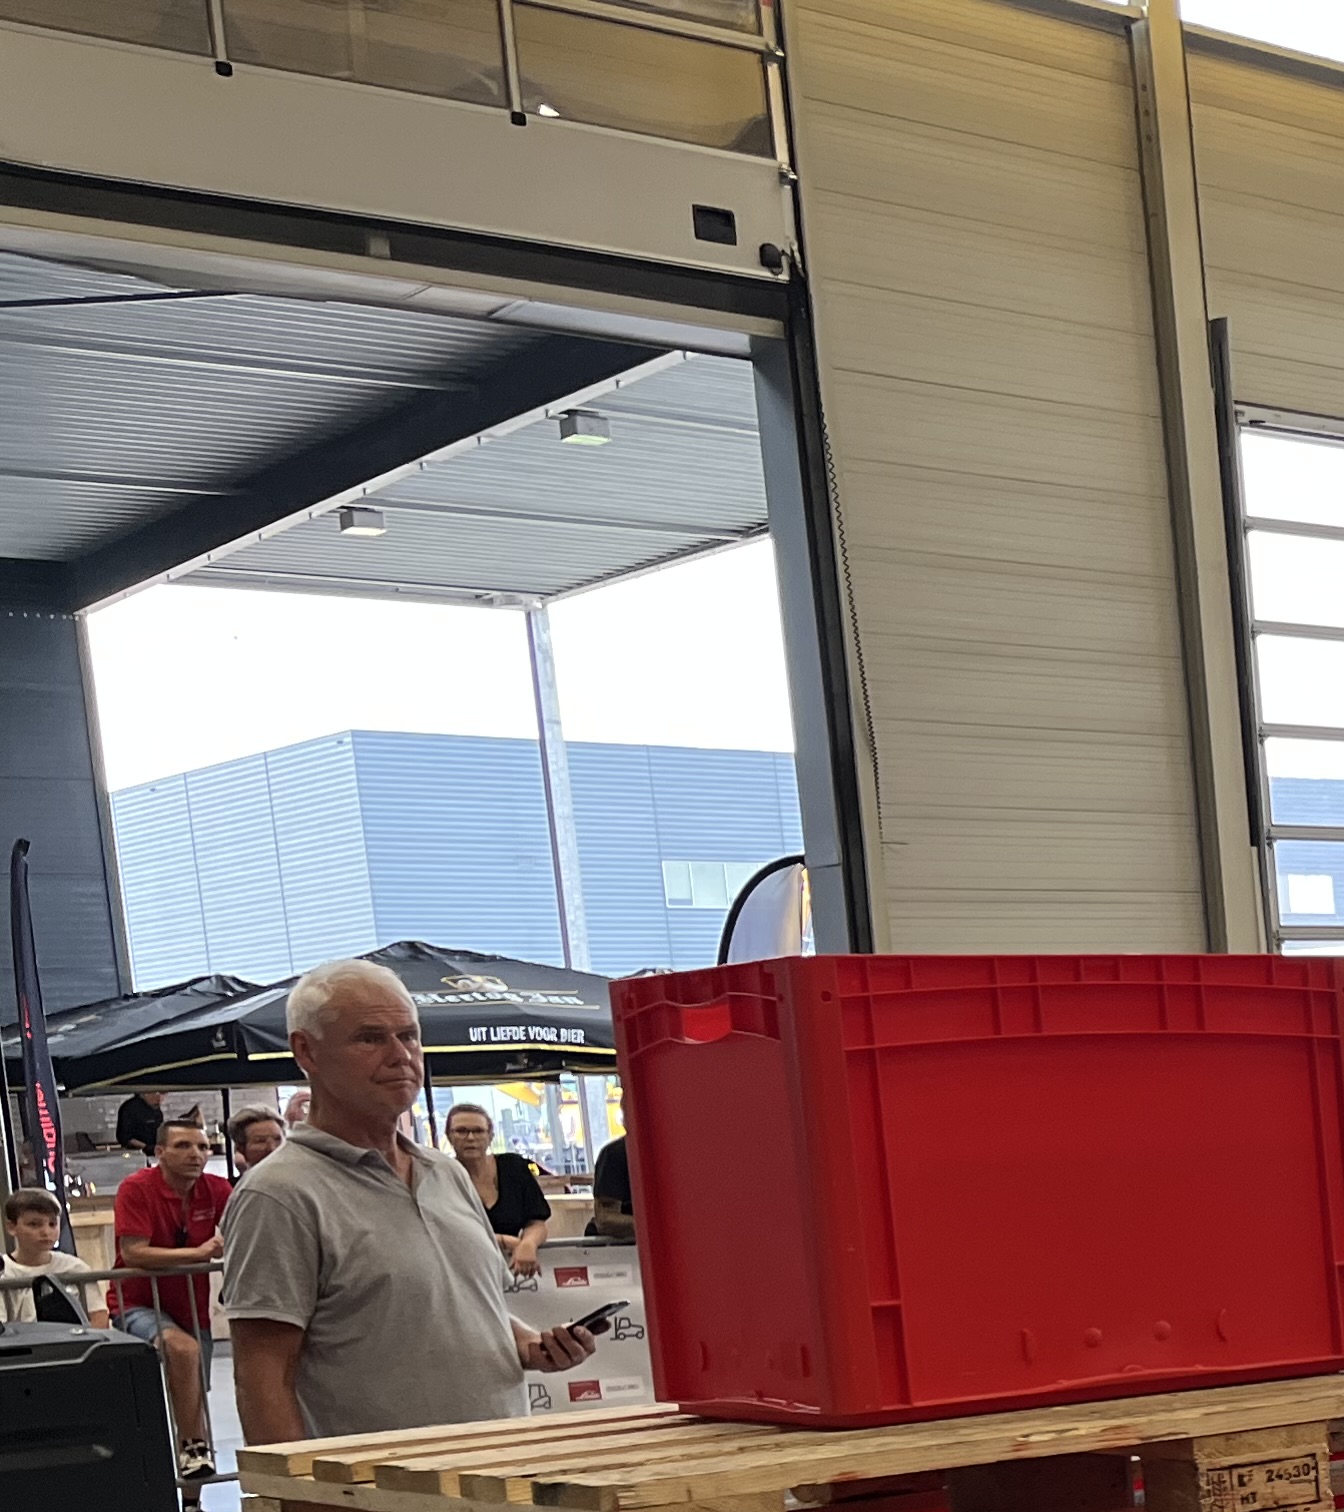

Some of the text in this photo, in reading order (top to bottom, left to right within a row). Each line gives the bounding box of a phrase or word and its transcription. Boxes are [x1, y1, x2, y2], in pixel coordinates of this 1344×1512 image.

[469, 1026, 585, 1044] UIT LIEFDE VOOR BIER
